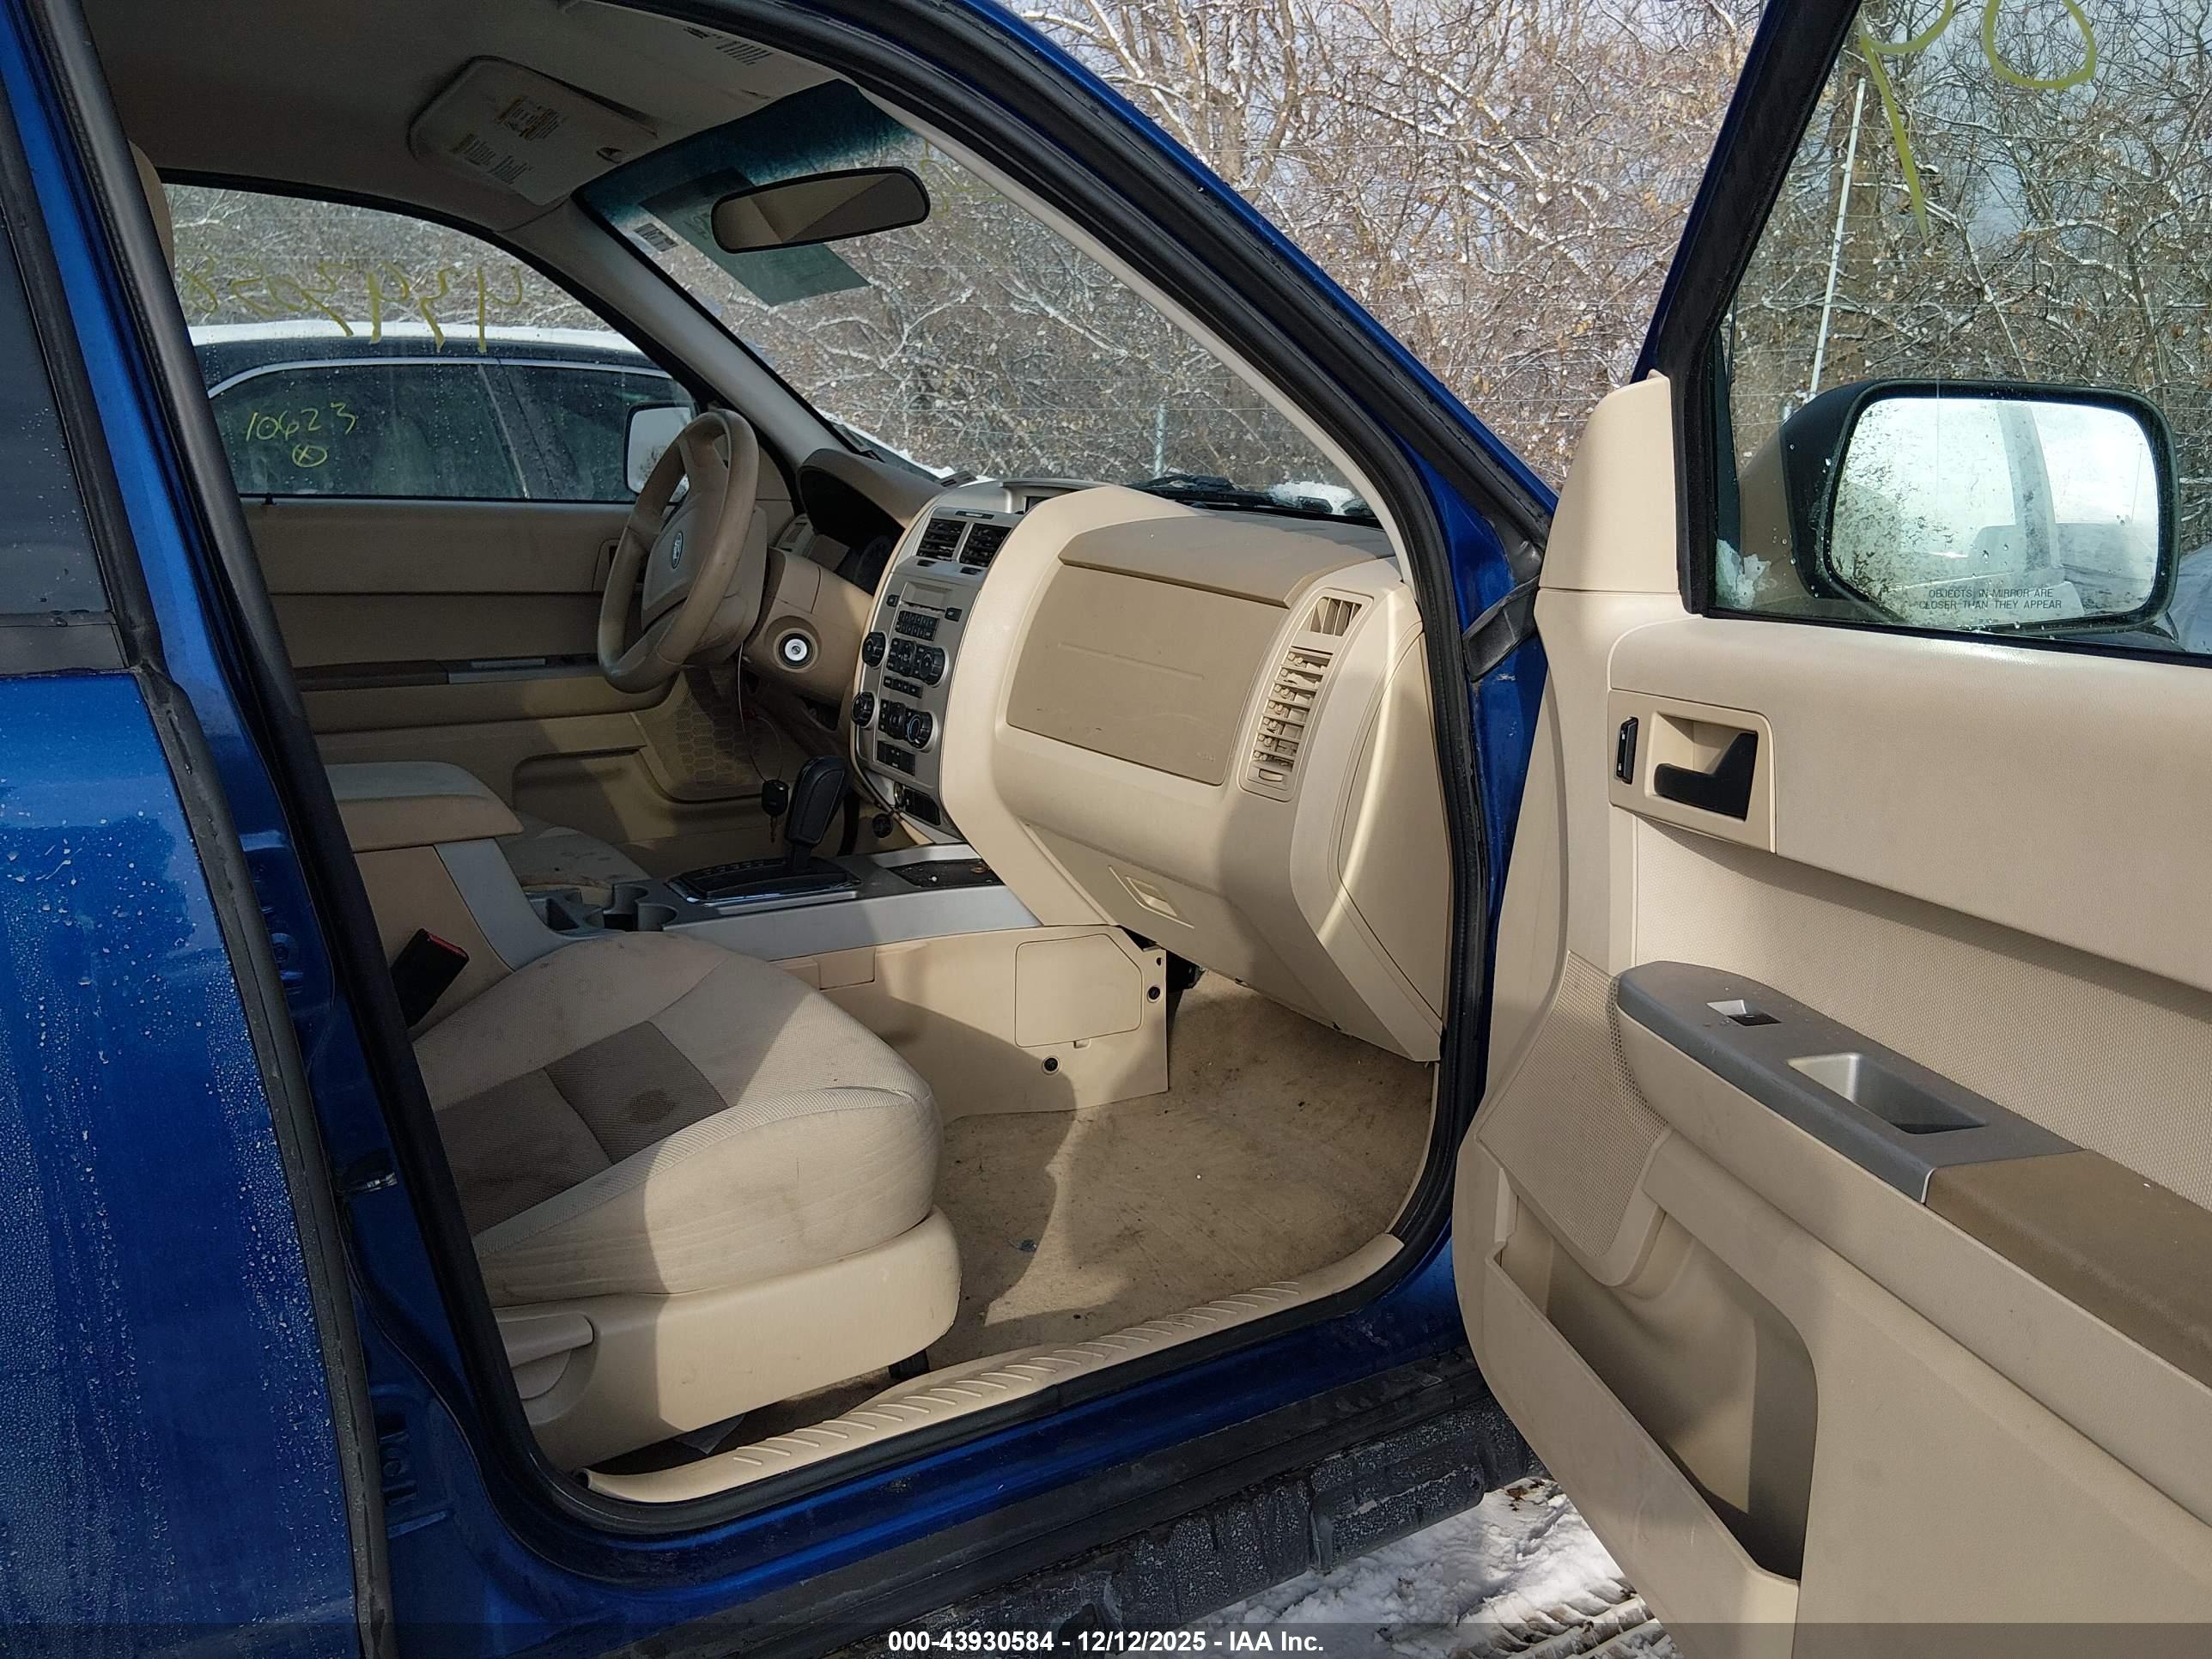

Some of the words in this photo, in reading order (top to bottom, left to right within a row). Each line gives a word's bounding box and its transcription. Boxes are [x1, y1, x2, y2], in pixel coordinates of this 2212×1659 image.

[246, 401, 357, 442] 10623
[1929, 588, 1972, 599] OBJECTS
[1978, 589, 1989, 599] IN
[1992, 588, 2030, 599] MIRROR
[2033, 588, 2054, 598] ARE
[1918, 600, 1958, 611] CLOSER
[1963, 600, 1989, 610] THAN
[1995, 599, 2019, 610] THEY
[2023, 599, 2063, 609] APPEAR
